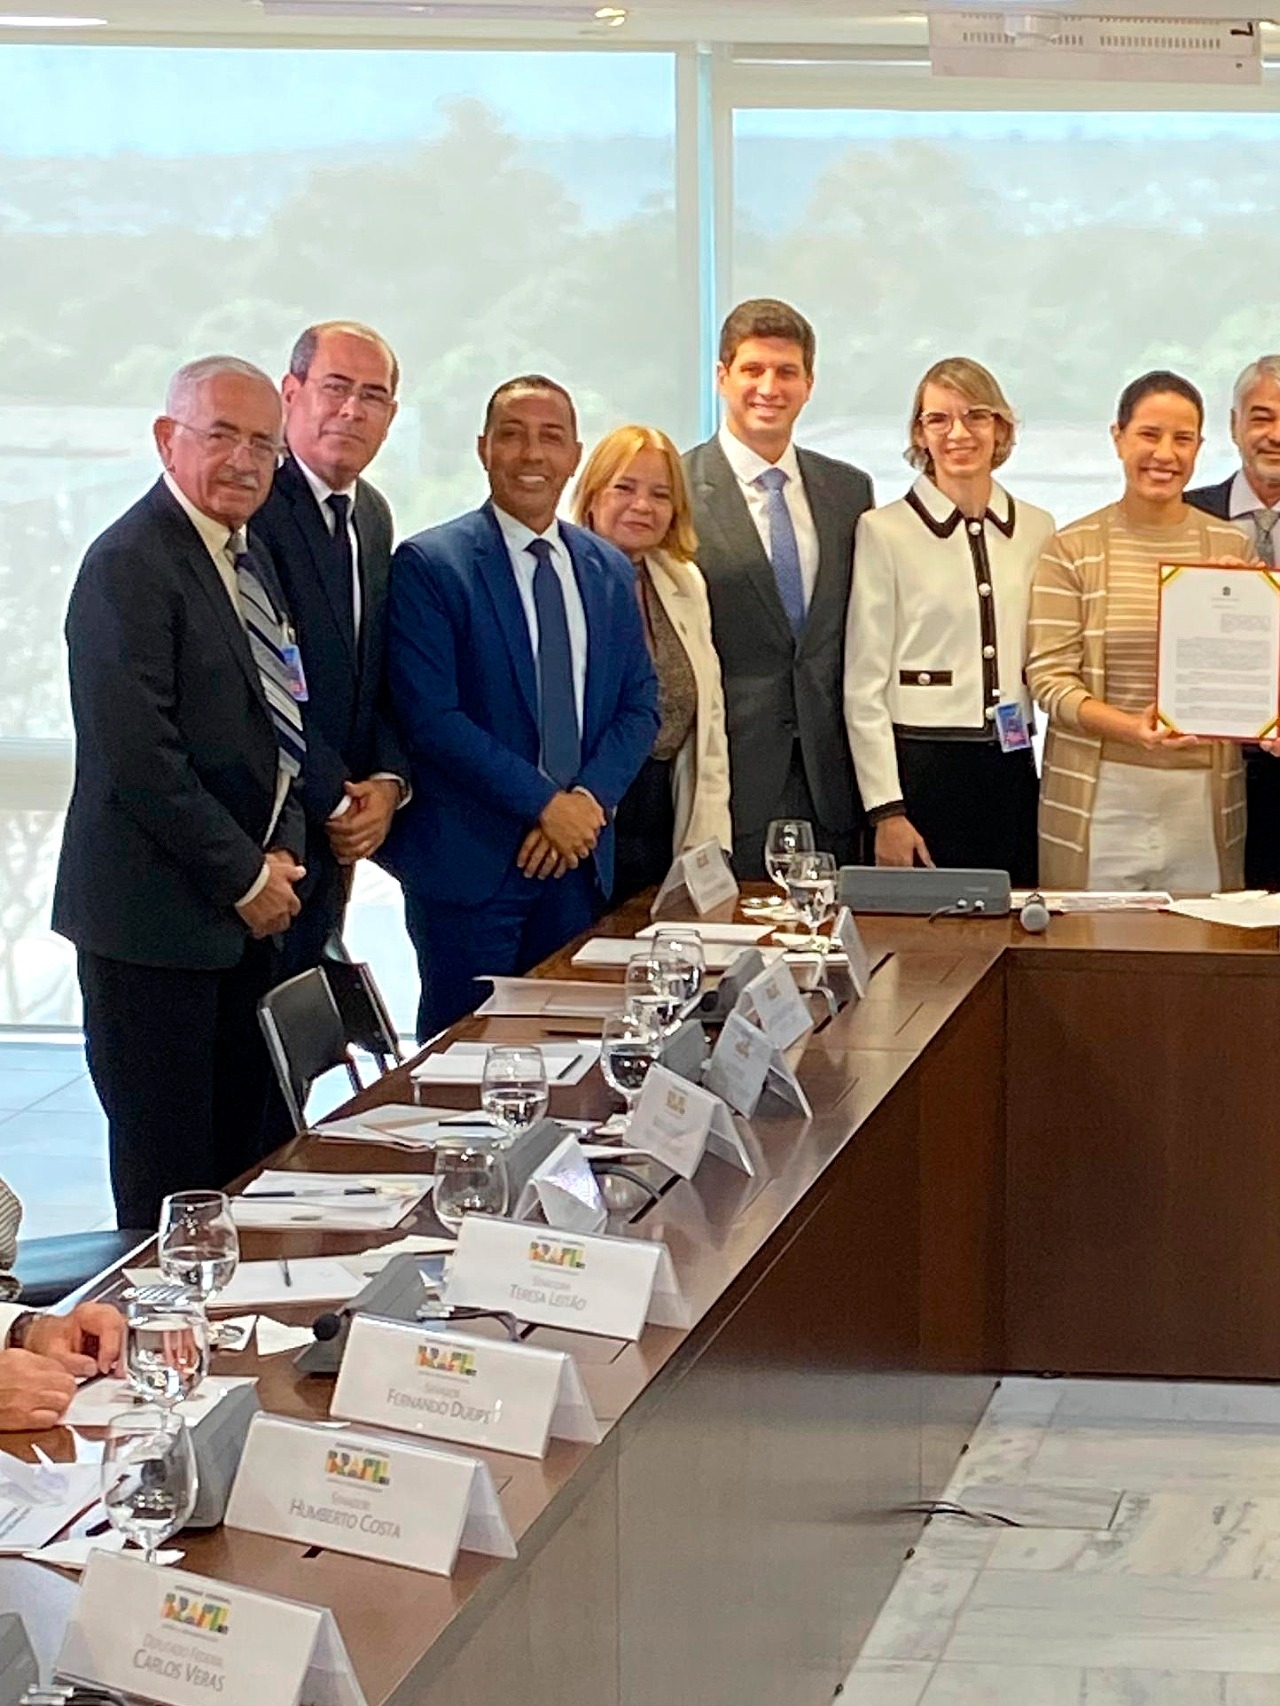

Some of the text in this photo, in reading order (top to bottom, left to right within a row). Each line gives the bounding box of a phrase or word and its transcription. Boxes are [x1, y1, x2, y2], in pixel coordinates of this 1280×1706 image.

[510, 1284, 546, 1304] TERESA
[386, 1388, 449, 1416] FERNANDO
[290, 1498, 401, 1538] HUMBERTO COSTA
[132, 1648, 226, 1692] CARLOS VERAS
